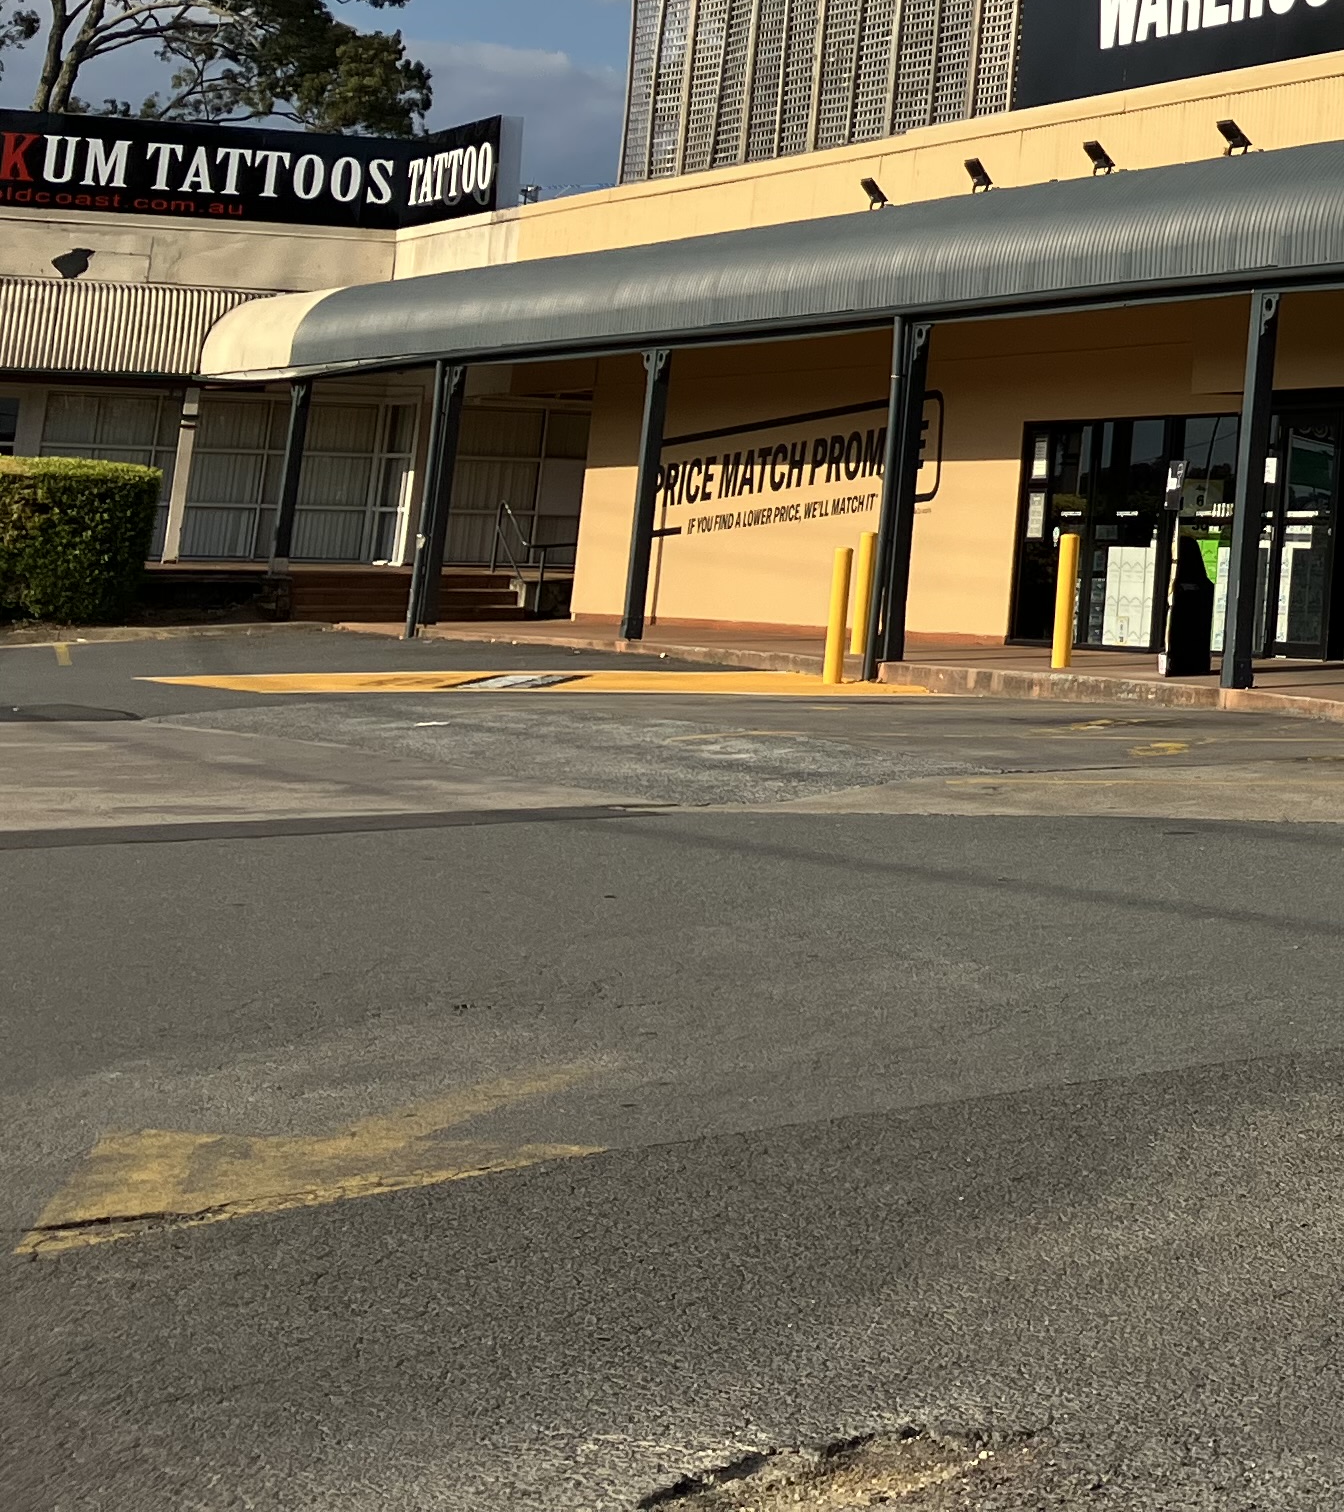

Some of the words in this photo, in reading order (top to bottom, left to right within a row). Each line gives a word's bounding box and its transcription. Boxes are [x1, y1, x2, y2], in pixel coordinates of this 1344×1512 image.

[146, 142, 394, 205] TATTOOS
[408, 142, 493, 206] TATTOO
[655, 456, 718, 508] PRICE
[718, 440, 807, 499] MATCH
[808, 420, 930, 486] PROM
[687, 517, 697, 535] IF
[697, 515, 715, 533] YOU
[714, 512, 735, 531] FIND
[735, 511, 741, 529] A
[742, 507, 773, 528] LOWER
[773, 503, 801, 524] PRICE,
[831, 494, 866, 516] MATCH
